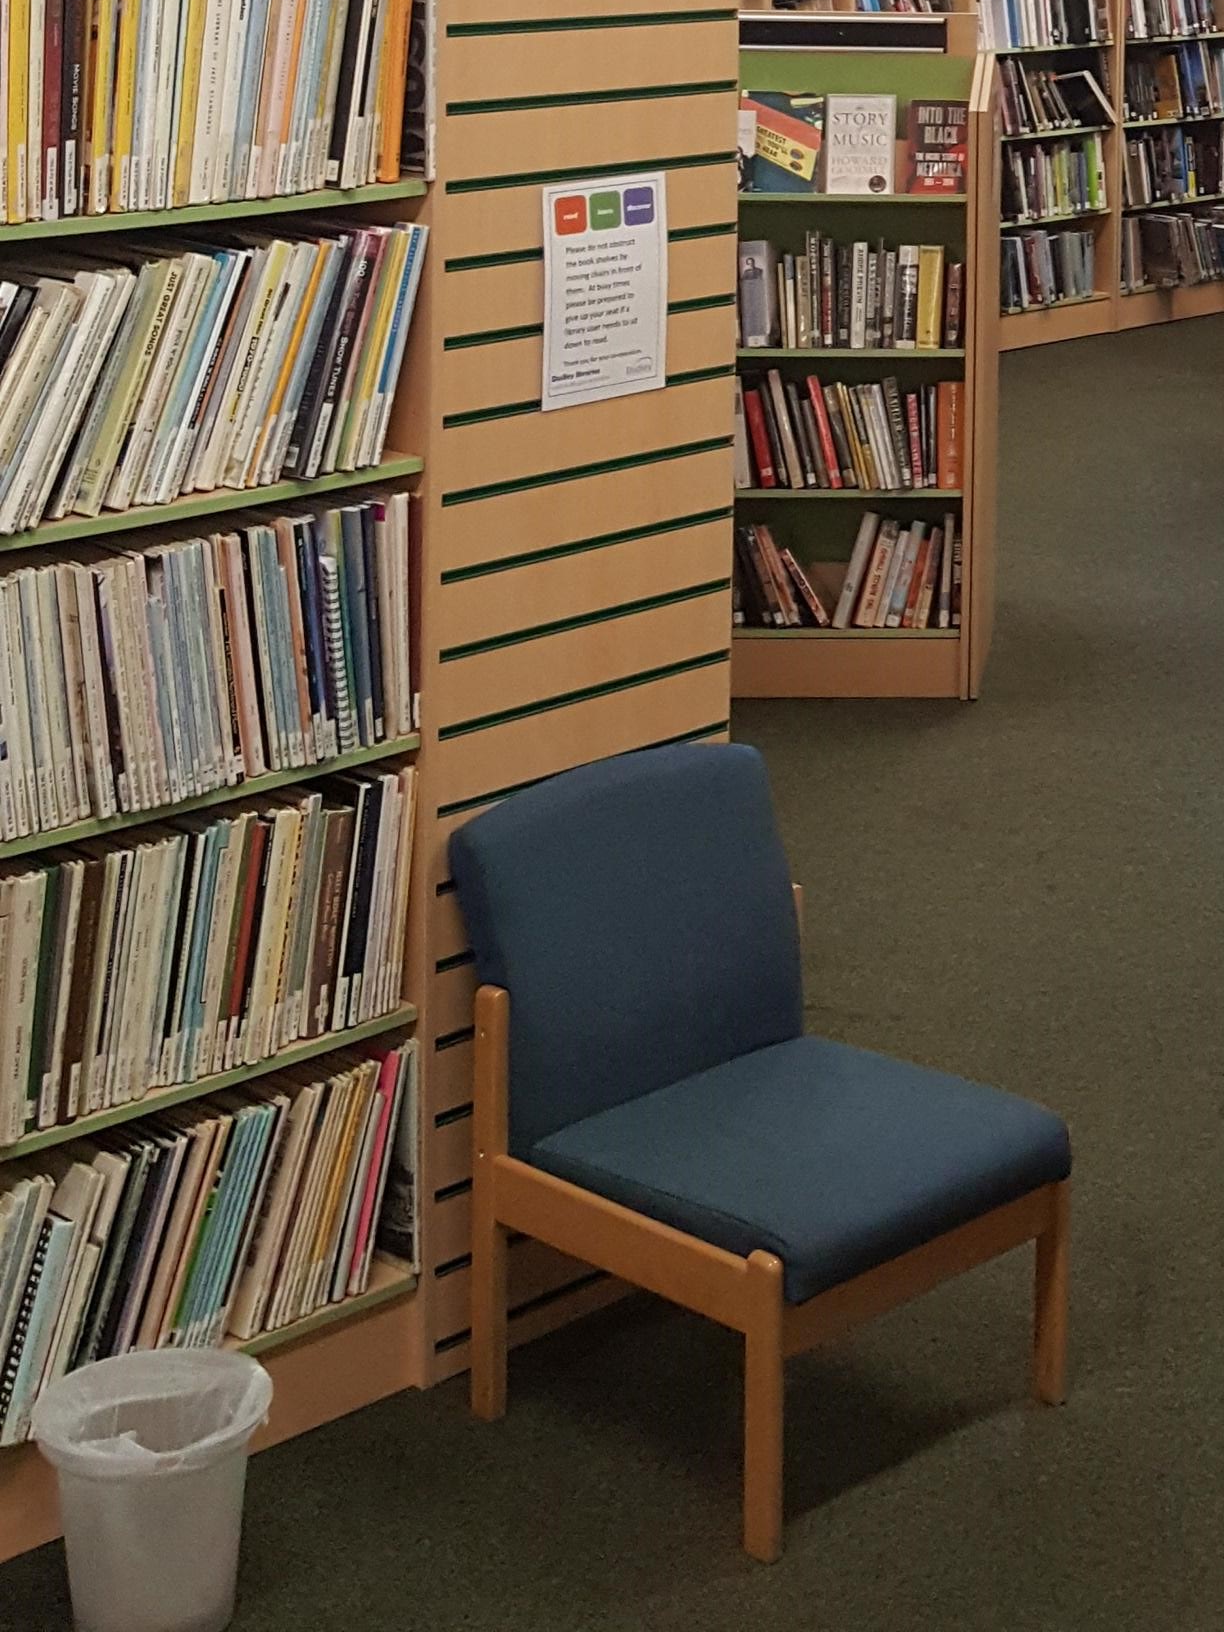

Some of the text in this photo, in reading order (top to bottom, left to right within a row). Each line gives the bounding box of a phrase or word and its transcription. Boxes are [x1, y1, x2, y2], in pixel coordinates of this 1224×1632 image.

[832, 112, 888, 126] STORY
[918, 106, 966, 125] INTO THE
[832, 133, 887, 146] MUSIC
[924, 126, 958, 144] BLACK
[565, 245, 586, 254] Please
[609, 239, 636, 249] obstruct
[565, 253, 628, 268] the book shelves by
[356, 260, 368, 277] 100
[566, 272, 590, 282] moving
[591, 270, 609, 279] chairs
[617, 266, 633, 274] front
[635, 264, 642, 272] of
[588, 284, 596, 292] At
[597, 283, 612, 292] busy
[613, 280, 631, 288] times
[565, 300, 586, 310] please
[597, 294, 626, 305] prepared
[144, 271, 178, 357] JUST GREAT SONGS
[565, 315, 579, 324] give
[580, 313, 588, 321] up
[590, 310, 605, 320] your
[606, 307, 619, 315] seat
[564, 326, 585, 336] library
[586, 324, 601, 332] user
[602, 321, 621, 329] needs
[335, 337, 349, 365] SHOW
[564, 341, 582, 350] down
[626, 364, 652, 376] Dudley
[327, 366, 341, 397] TUNES
[551, 373, 574, 383] Dudley
